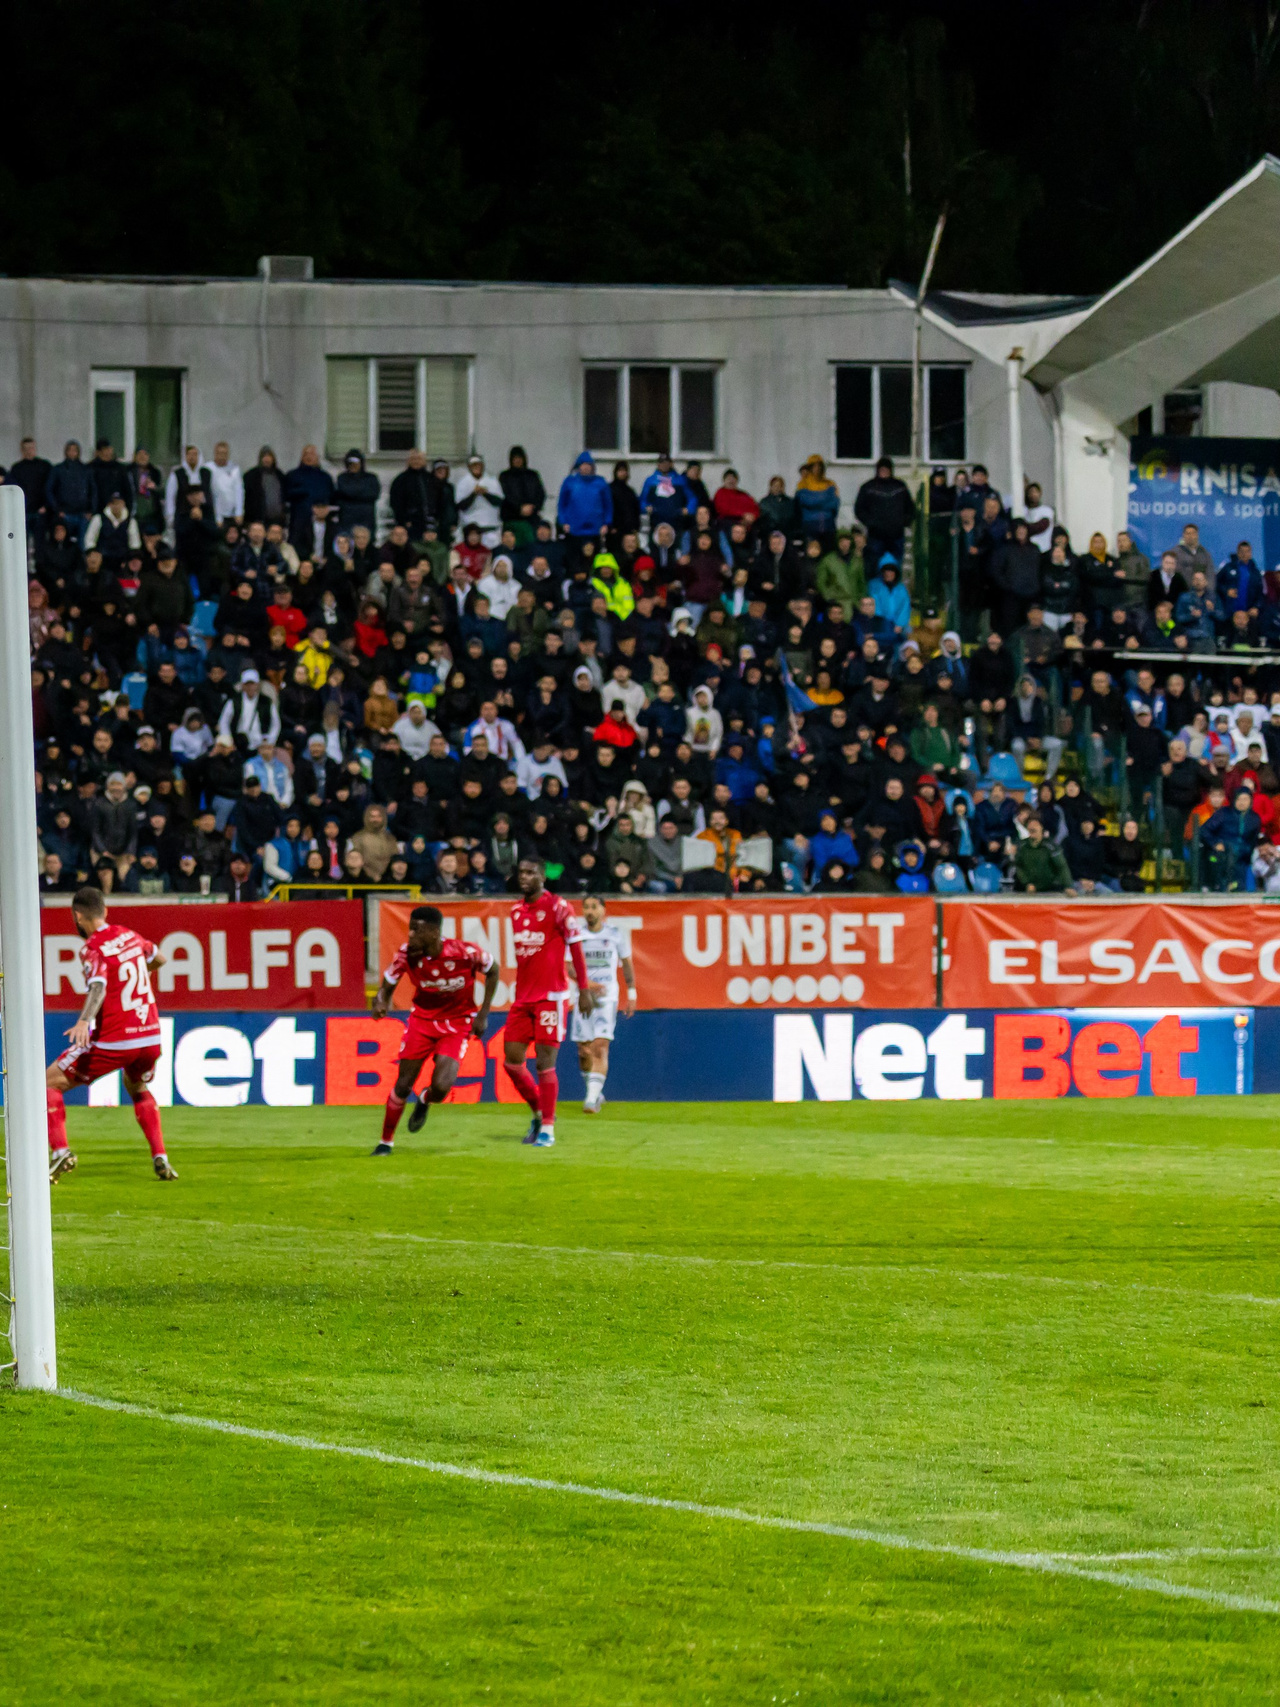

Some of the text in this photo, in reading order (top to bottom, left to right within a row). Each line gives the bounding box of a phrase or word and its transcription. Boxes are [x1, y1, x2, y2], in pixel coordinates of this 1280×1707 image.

[1214, 500, 1225, 517] &
[158, 928, 341, 991] ALFA
[442, 915, 643, 969] NIT
[681, 912, 905, 967] UNIBET
[118, 955, 156, 1012] 24
[540, 1010, 558, 1027] 28
[773, 1013, 1199, 1103] NetBet
